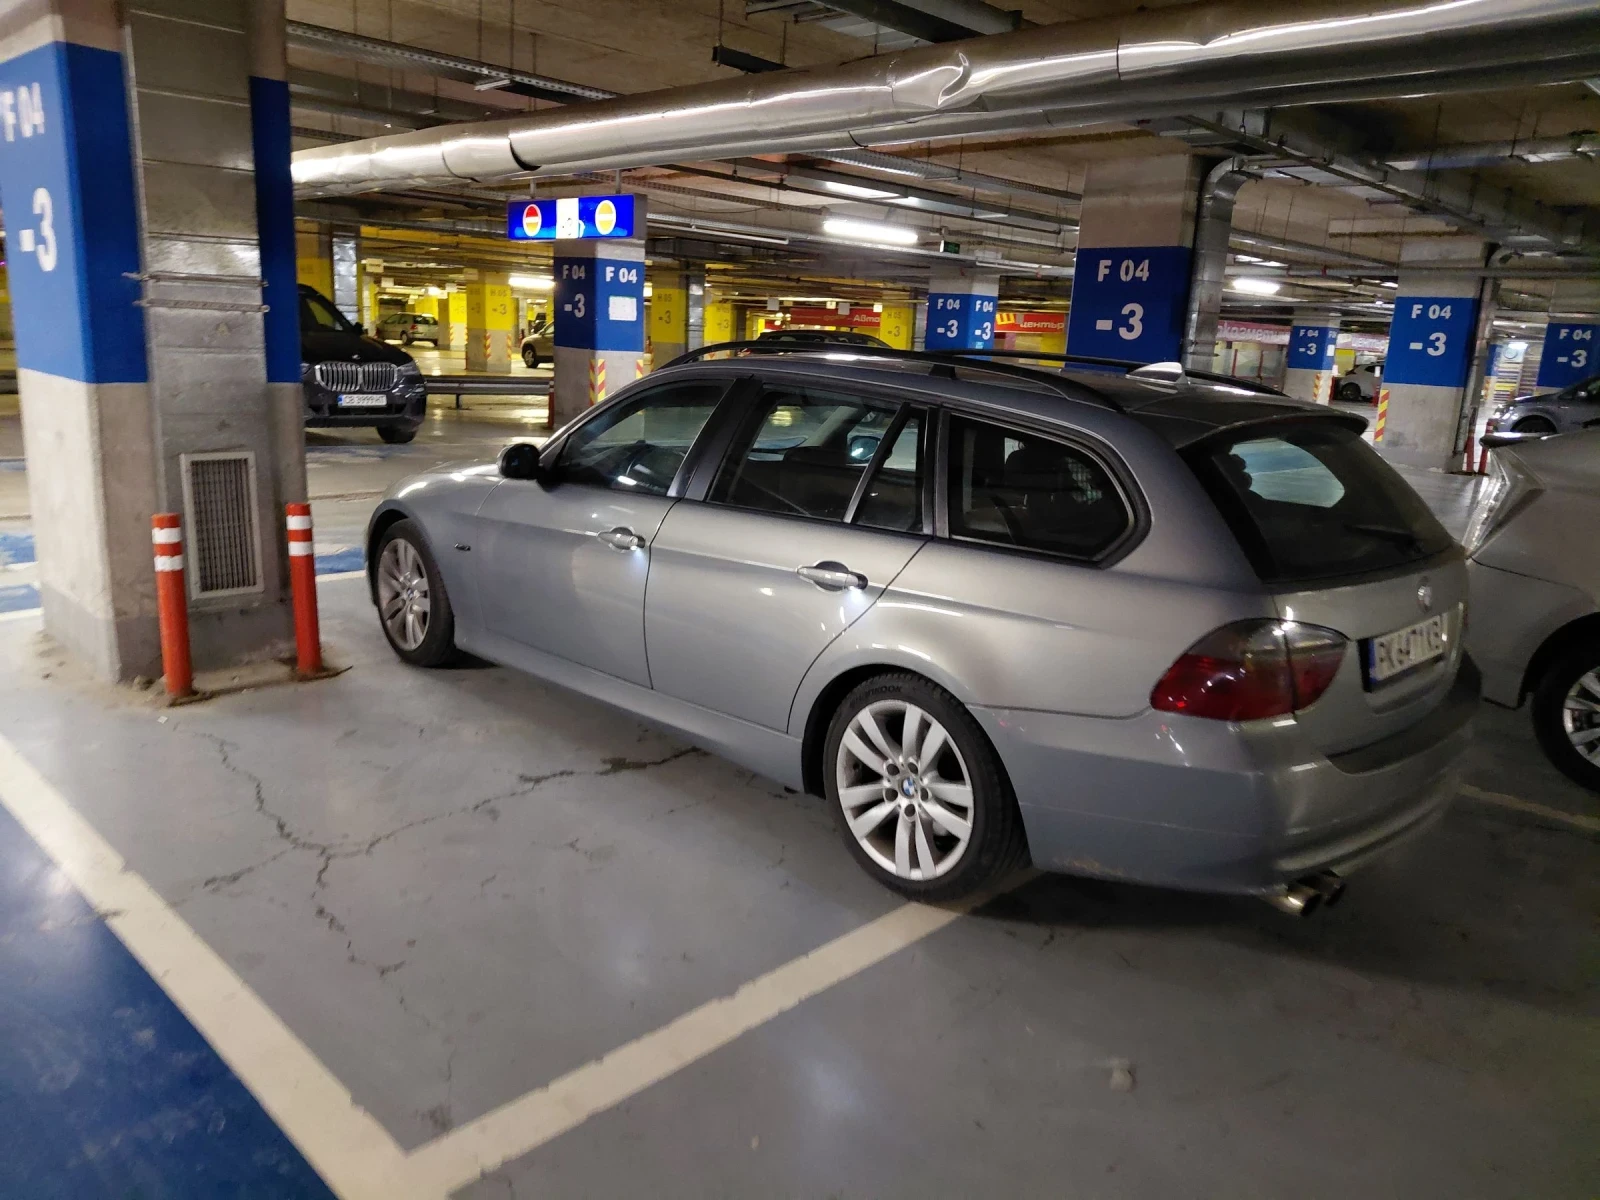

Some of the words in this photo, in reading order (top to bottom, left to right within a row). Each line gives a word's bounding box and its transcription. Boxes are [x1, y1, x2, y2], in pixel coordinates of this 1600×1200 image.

[0, 91, 16, 141] F
[18, 82, 45, 137] 04
[19, 187, 57, 271] -3
[562, 265, 570, 279] F
[572, 265, 585, 280] 04
[605, 266, 615, 282] F
[619, 268, 637, 283] 04
[1098, 260, 1112, 282] F
[1120, 259, 1149, 282] 04
[563, 293, 585, 318] -3
[937, 298, 944, 310] F
[946, 299, 960, 310] 04
[975, 300, 981, 312] F
[983, 301, 993, 313] 04
[1411, 304, 1423, 318] F
[1428, 304, 1452, 319] 04
[937, 319, 958, 338] -3
[1096, 303, 1144, 340] -3
[974, 322, 991, 340] -3
[1300, 329, 1306, 337] F
[1559, 328, 1569, 340] F
[1572, 329, 1592, 341] 04
[1299, 343, 1317, 355] -3
[1409, 332, 1447, 356] -3
[1556, 349, 1587, 368] -3
